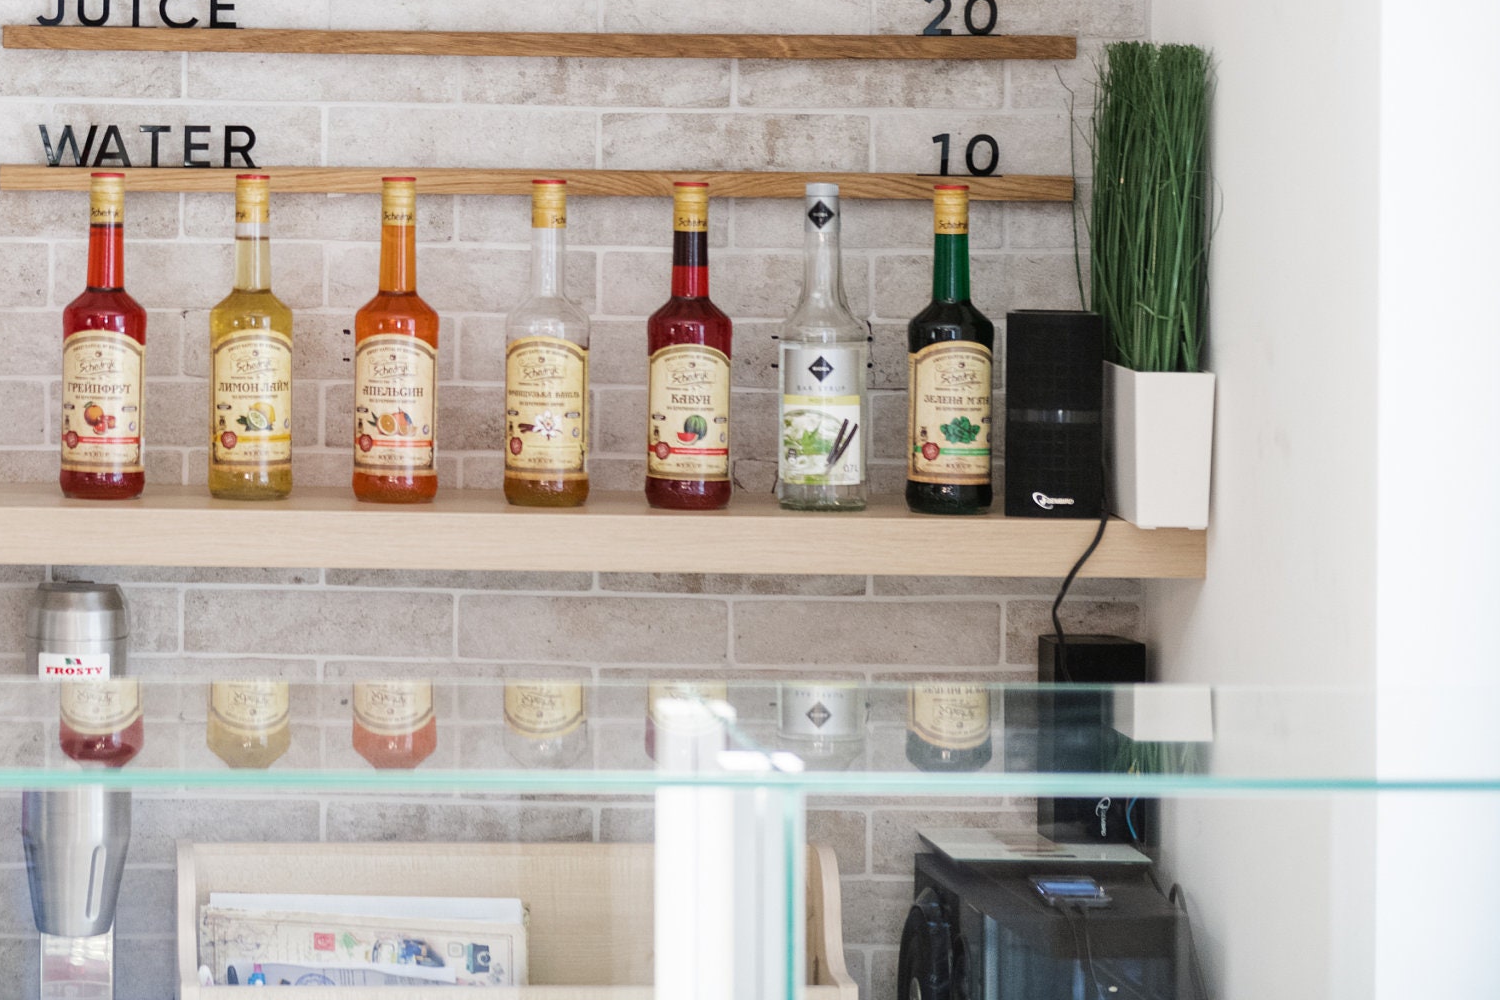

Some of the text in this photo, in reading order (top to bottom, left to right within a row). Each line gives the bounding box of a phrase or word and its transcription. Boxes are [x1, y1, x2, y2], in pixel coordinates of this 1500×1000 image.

[39, 124, 999, 176] WATER 10
[67, 380, 132, 394] ГРЕЙПФРУТ
[218, 379, 290, 393] ЛИМОН ЛАЙМ
[362, 385, 424, 398] АПЕЛЬСИН
[670, 393, 711, 406] КАВУН
[923, 394, 963, 406] ЗЕЛЕНА
[45, 666, 103, 675] FROSTY
